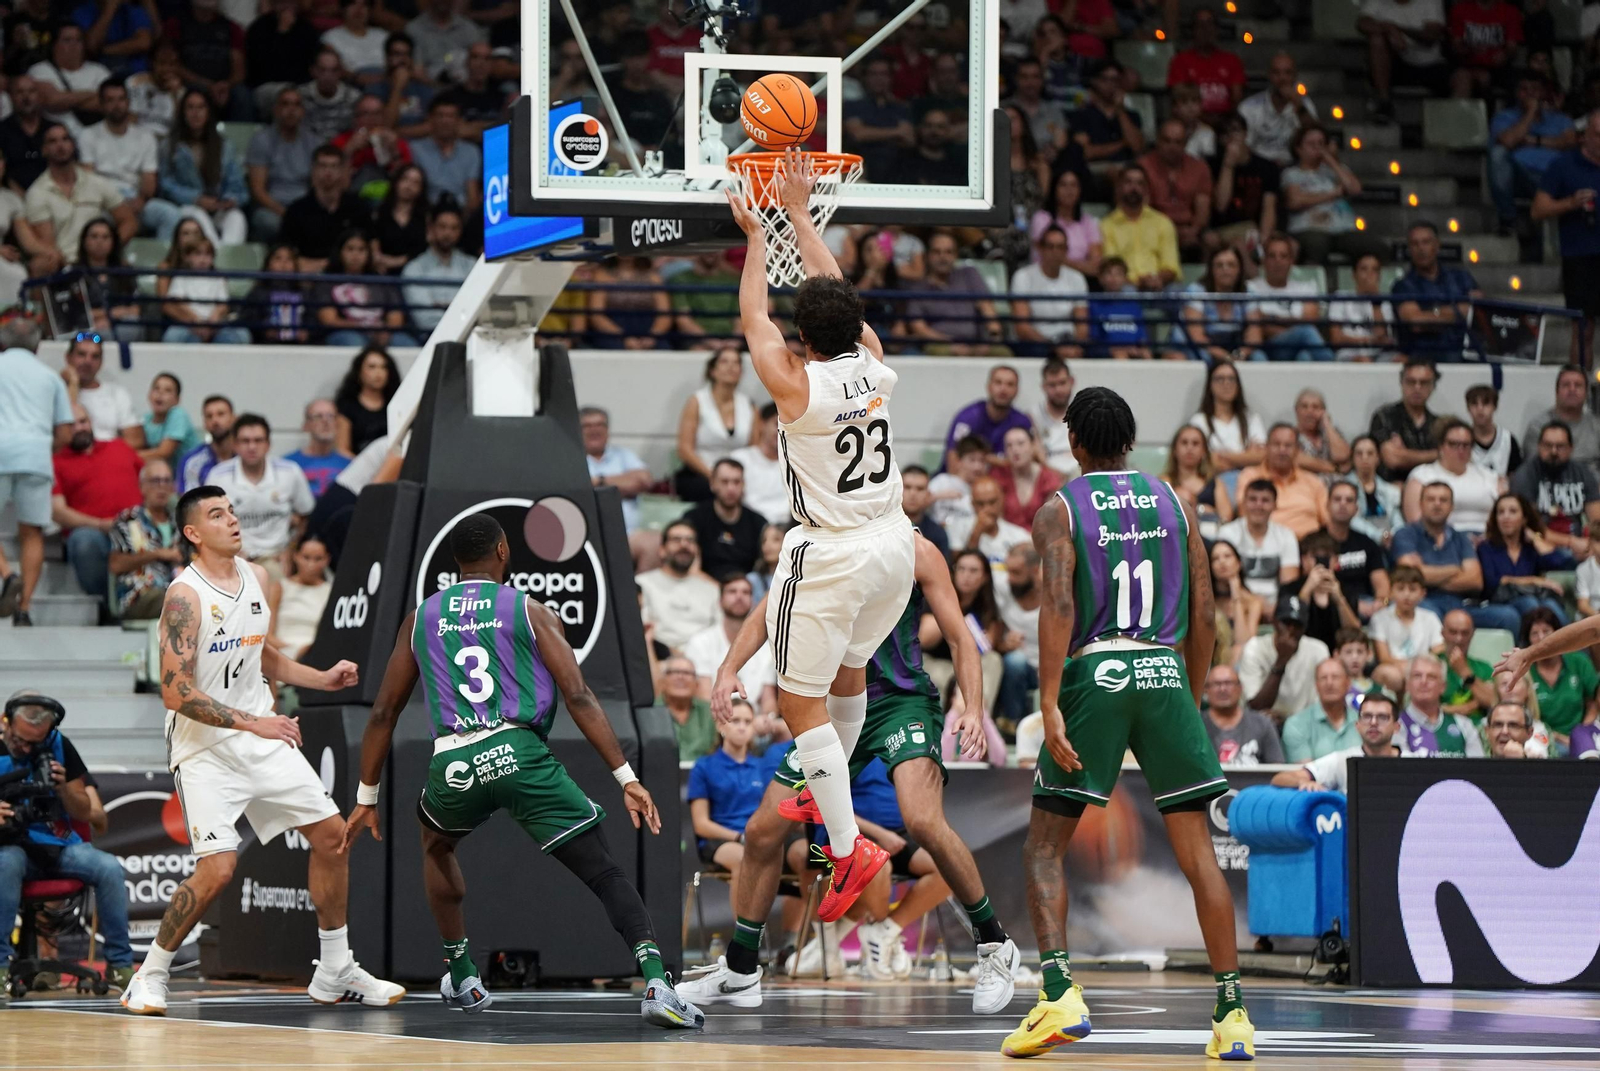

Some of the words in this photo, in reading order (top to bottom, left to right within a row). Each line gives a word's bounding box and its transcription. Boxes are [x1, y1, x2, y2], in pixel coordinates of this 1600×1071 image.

[562, 136, 600, 144] supercopa
[565, 142, 600, 151] endesa
[835, 418, 892, 494] 23
[1090, 489, 1159, 511] Carter
[1111, 559, 1154, 630] 11
[333, 586, 369, 630] acb
[448, 596, 492, 617] Ejim
[207, 634, 266, 654] AUTOHER
[1132, 656, 1179, 669] COSTA
[1134, 668, 1159, 679] DEL
[1160, 667, 1181, 679] SOL
[453, 645, 495, 704] 3
[1136, 677, 1182, 690] MÁLAGA
[472, 743, 516, 766] COSTA
[475, 762, 495, 777] DEL
[494, 754, 518, 768] SOL
[478, 763, 520, 785] MÁLAGA
